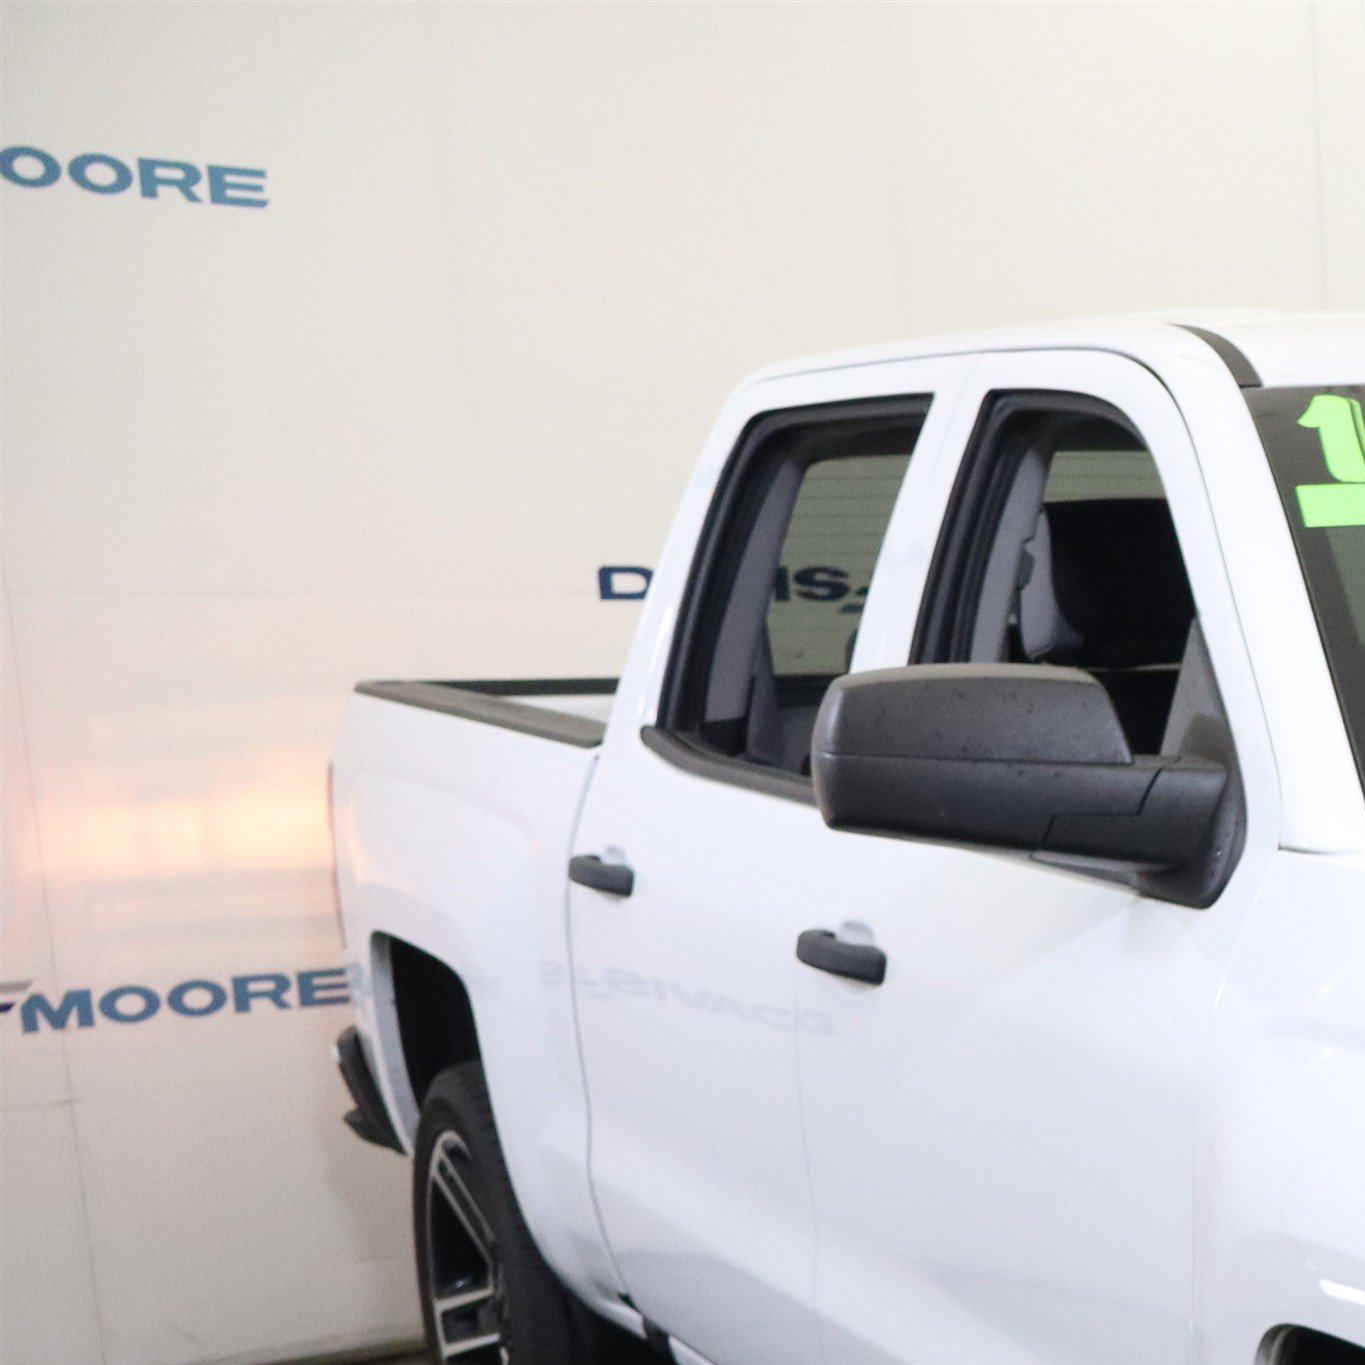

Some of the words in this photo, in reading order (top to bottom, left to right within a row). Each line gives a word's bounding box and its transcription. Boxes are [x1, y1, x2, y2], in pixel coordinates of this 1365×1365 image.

[0, 144, 268, 208] OORE
[597, 565, 850, 602] DIS
[20, 967, 352, 1034] MOORE
